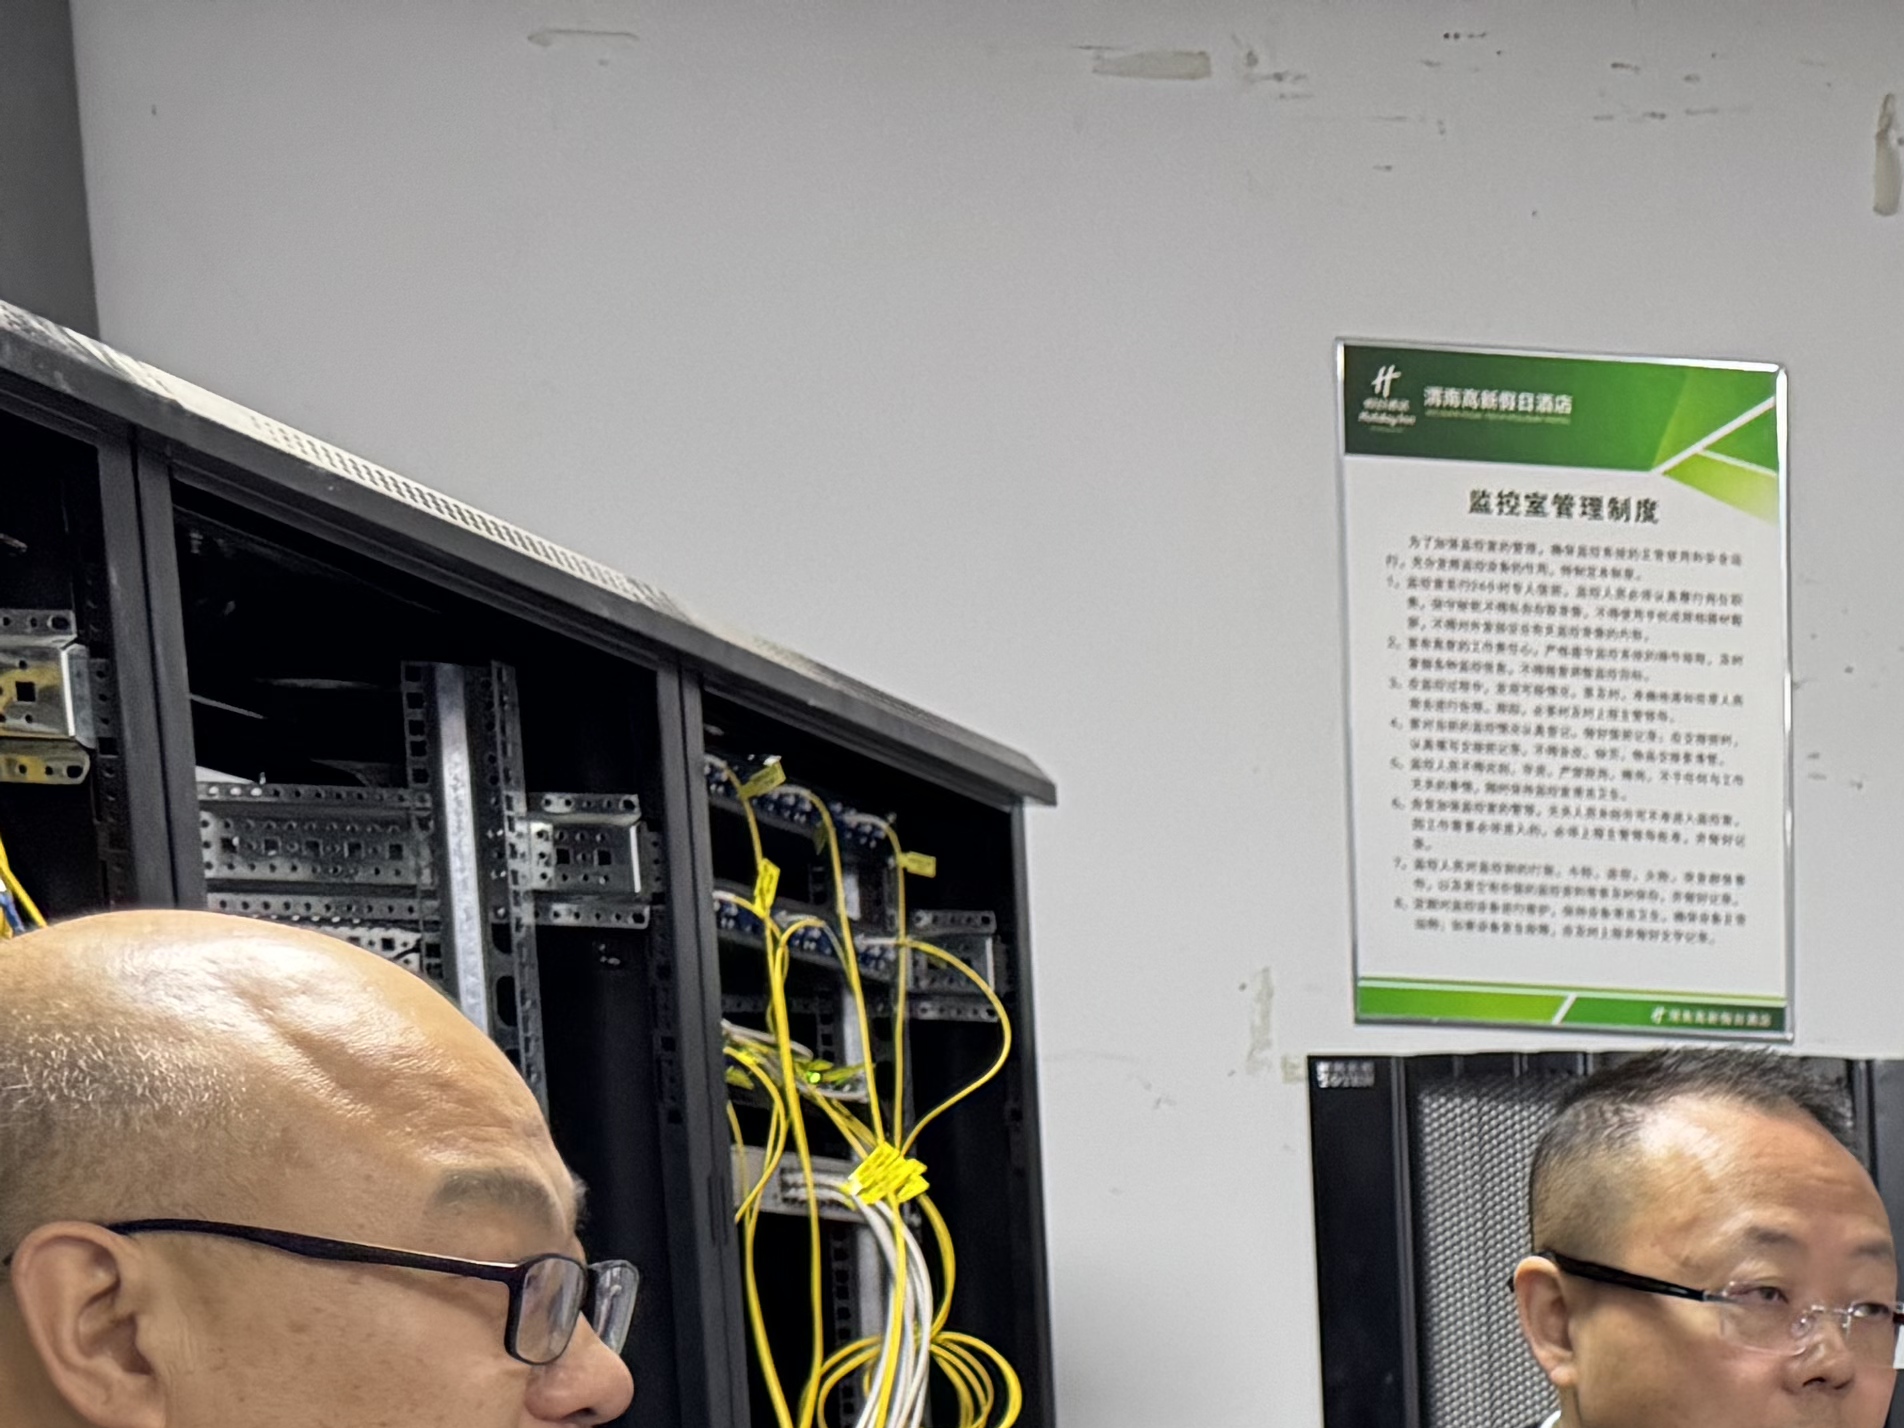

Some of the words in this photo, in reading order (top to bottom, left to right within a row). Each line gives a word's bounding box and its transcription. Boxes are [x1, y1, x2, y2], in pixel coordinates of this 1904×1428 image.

[1424, 386, 1573, 415] 渭南高新假日酒店
[1468, 489, 1660, 525] 监控室管理制度
